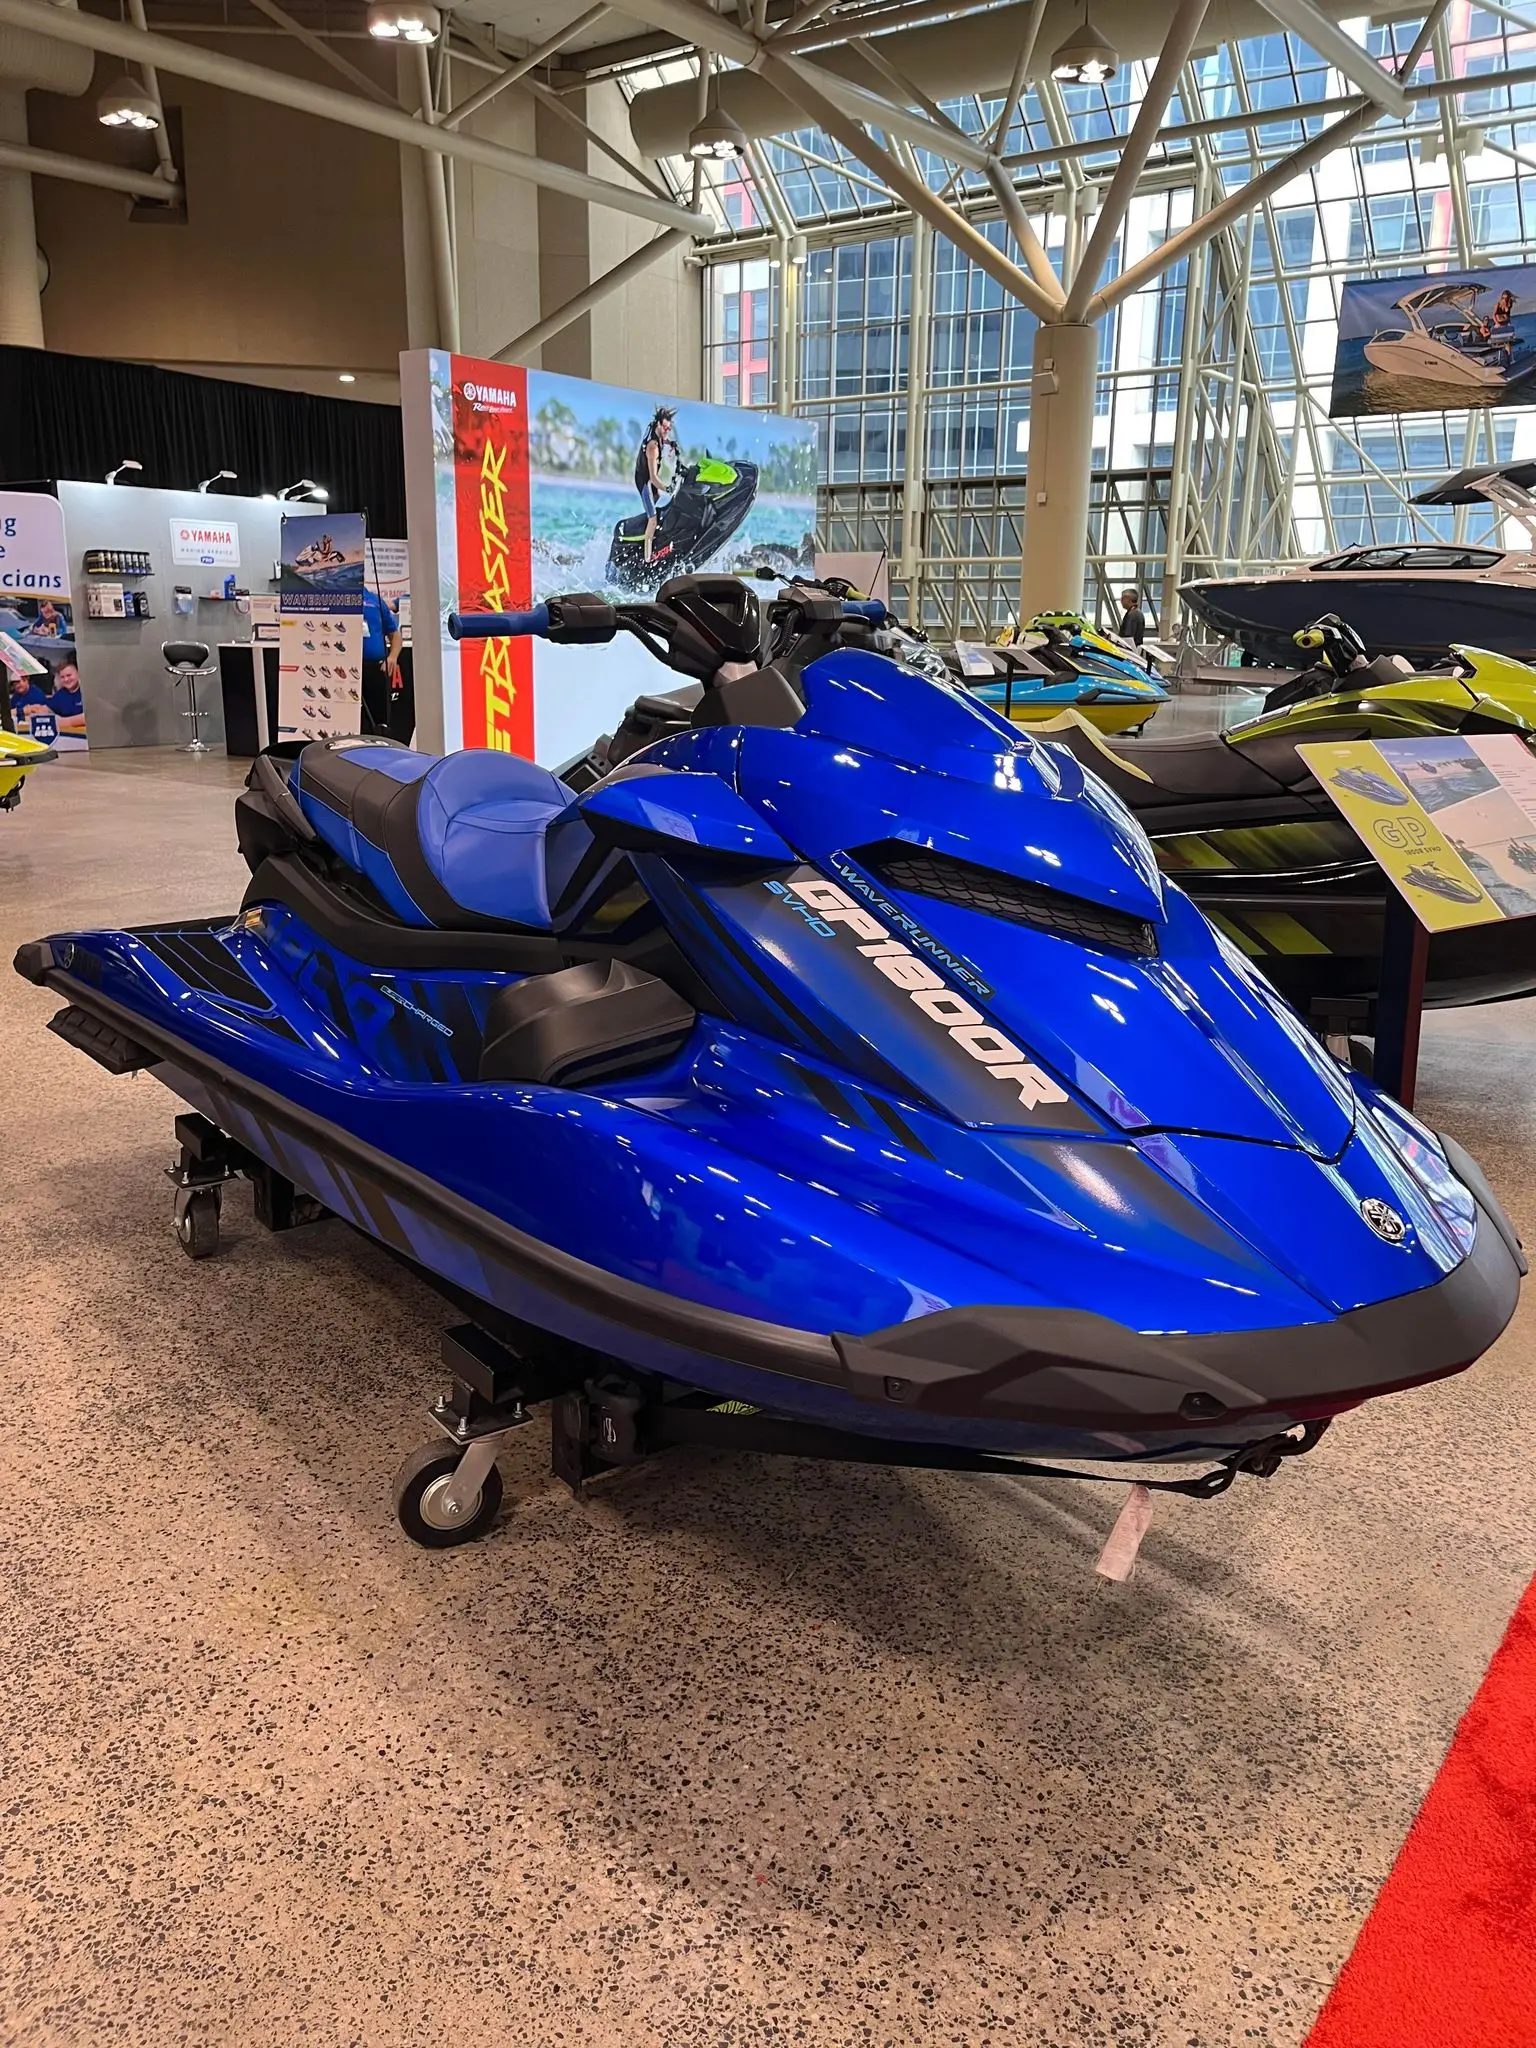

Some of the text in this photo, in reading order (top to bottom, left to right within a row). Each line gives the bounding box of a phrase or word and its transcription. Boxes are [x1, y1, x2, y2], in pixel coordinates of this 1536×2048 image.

[475, 385, 517, 408] YAMAHA
[191, 530, 231, 544] YAMAHA
[1372, 816, 1427, 849] GP
[763, 880, 837, 938] SVHO
[839, 865, 991, 996] WAVERUNNER
[787, 880, 1070, 1111] GP1800R
